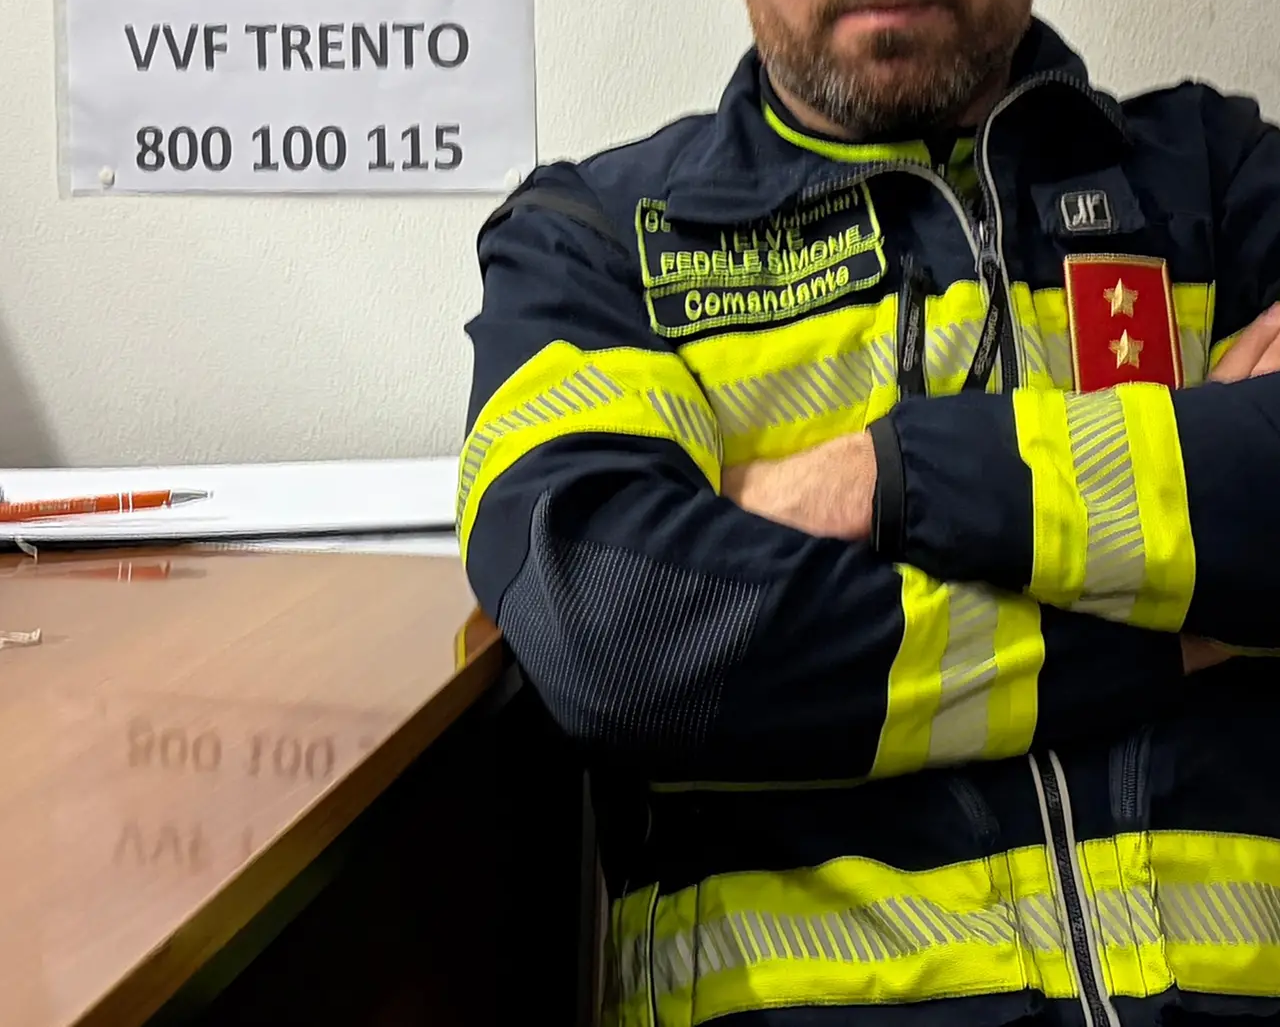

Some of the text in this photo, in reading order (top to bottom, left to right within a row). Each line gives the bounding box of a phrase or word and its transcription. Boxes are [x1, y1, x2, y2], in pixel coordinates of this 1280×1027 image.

[124, 21, 470, 72] VVF TRENTO
[135, 123, 464, 172] 800 100 115
[661, 224, 862, 277] FEDELE SIMONE
[684, 264, 850, 321] Comandante
